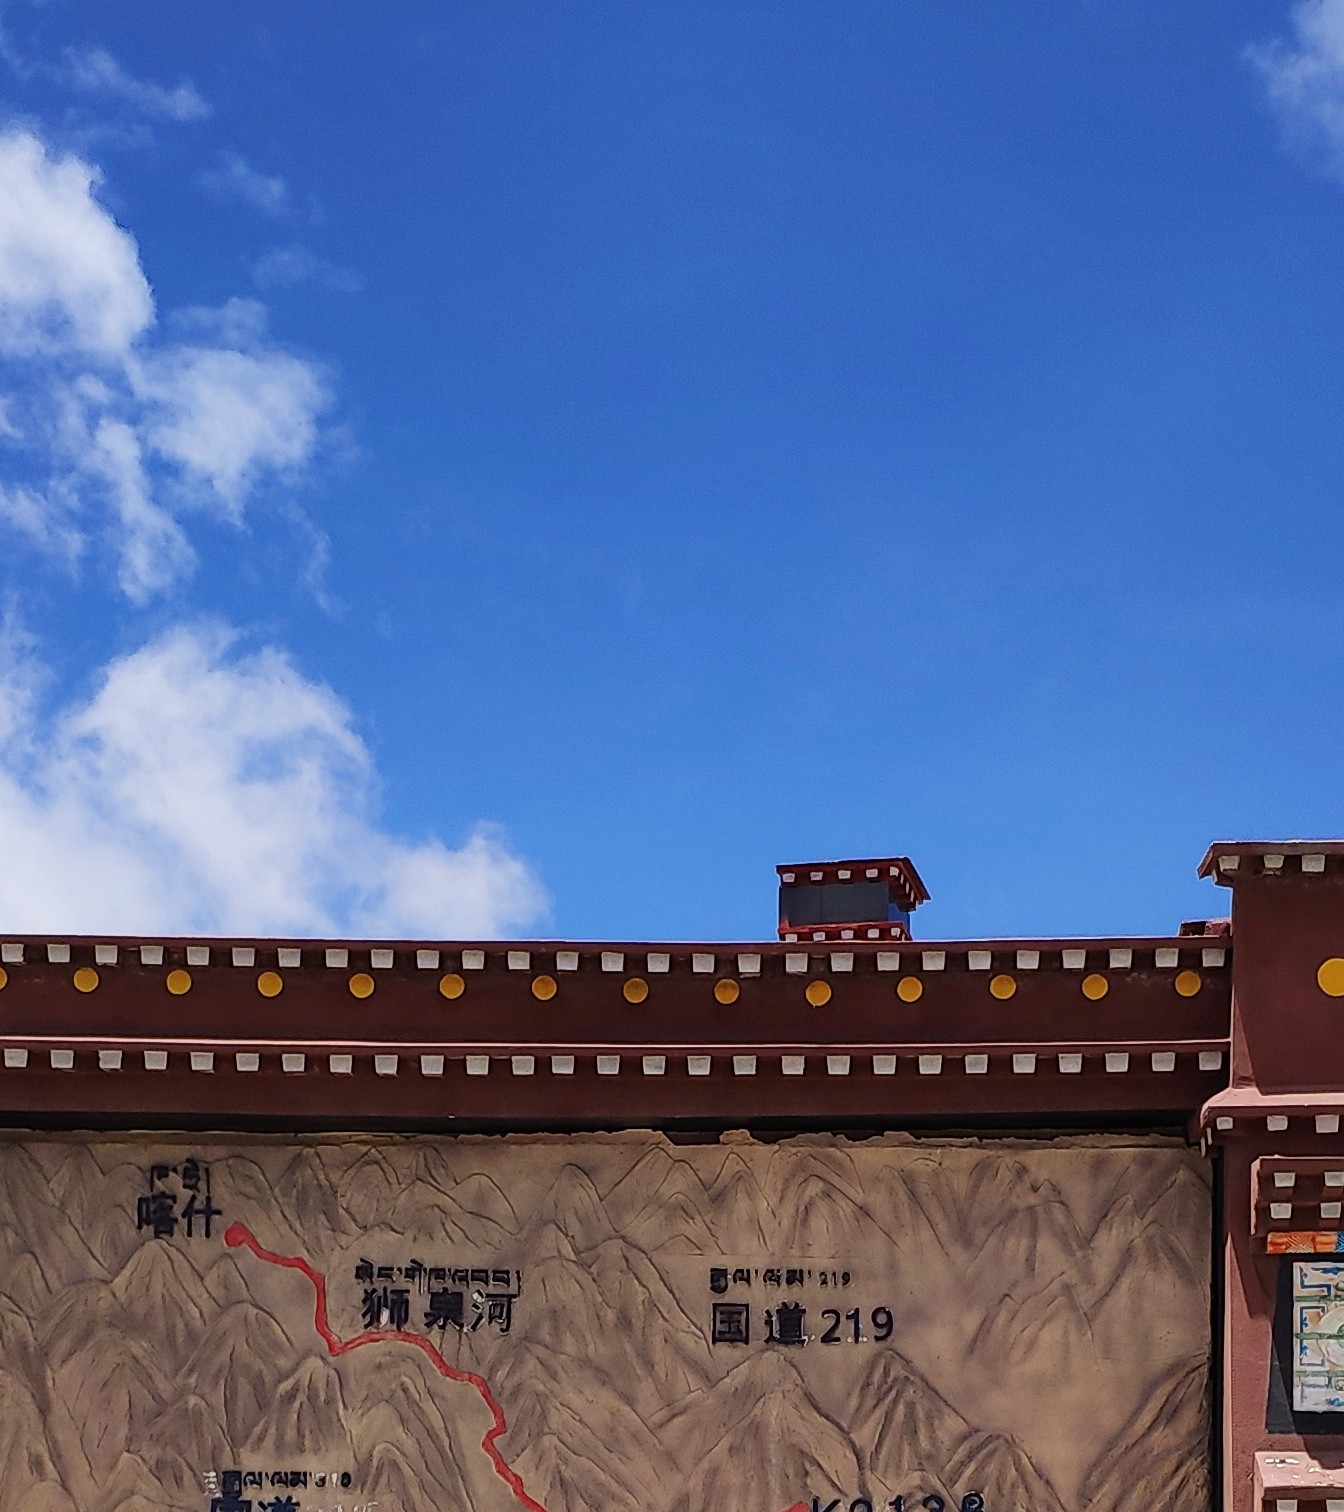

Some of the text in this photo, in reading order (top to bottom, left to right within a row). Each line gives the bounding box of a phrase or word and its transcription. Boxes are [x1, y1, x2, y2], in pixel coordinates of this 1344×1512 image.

[137, 1190, 223, 1239] 喀什
[361, 1285, 519, 1334] 狮泉河
